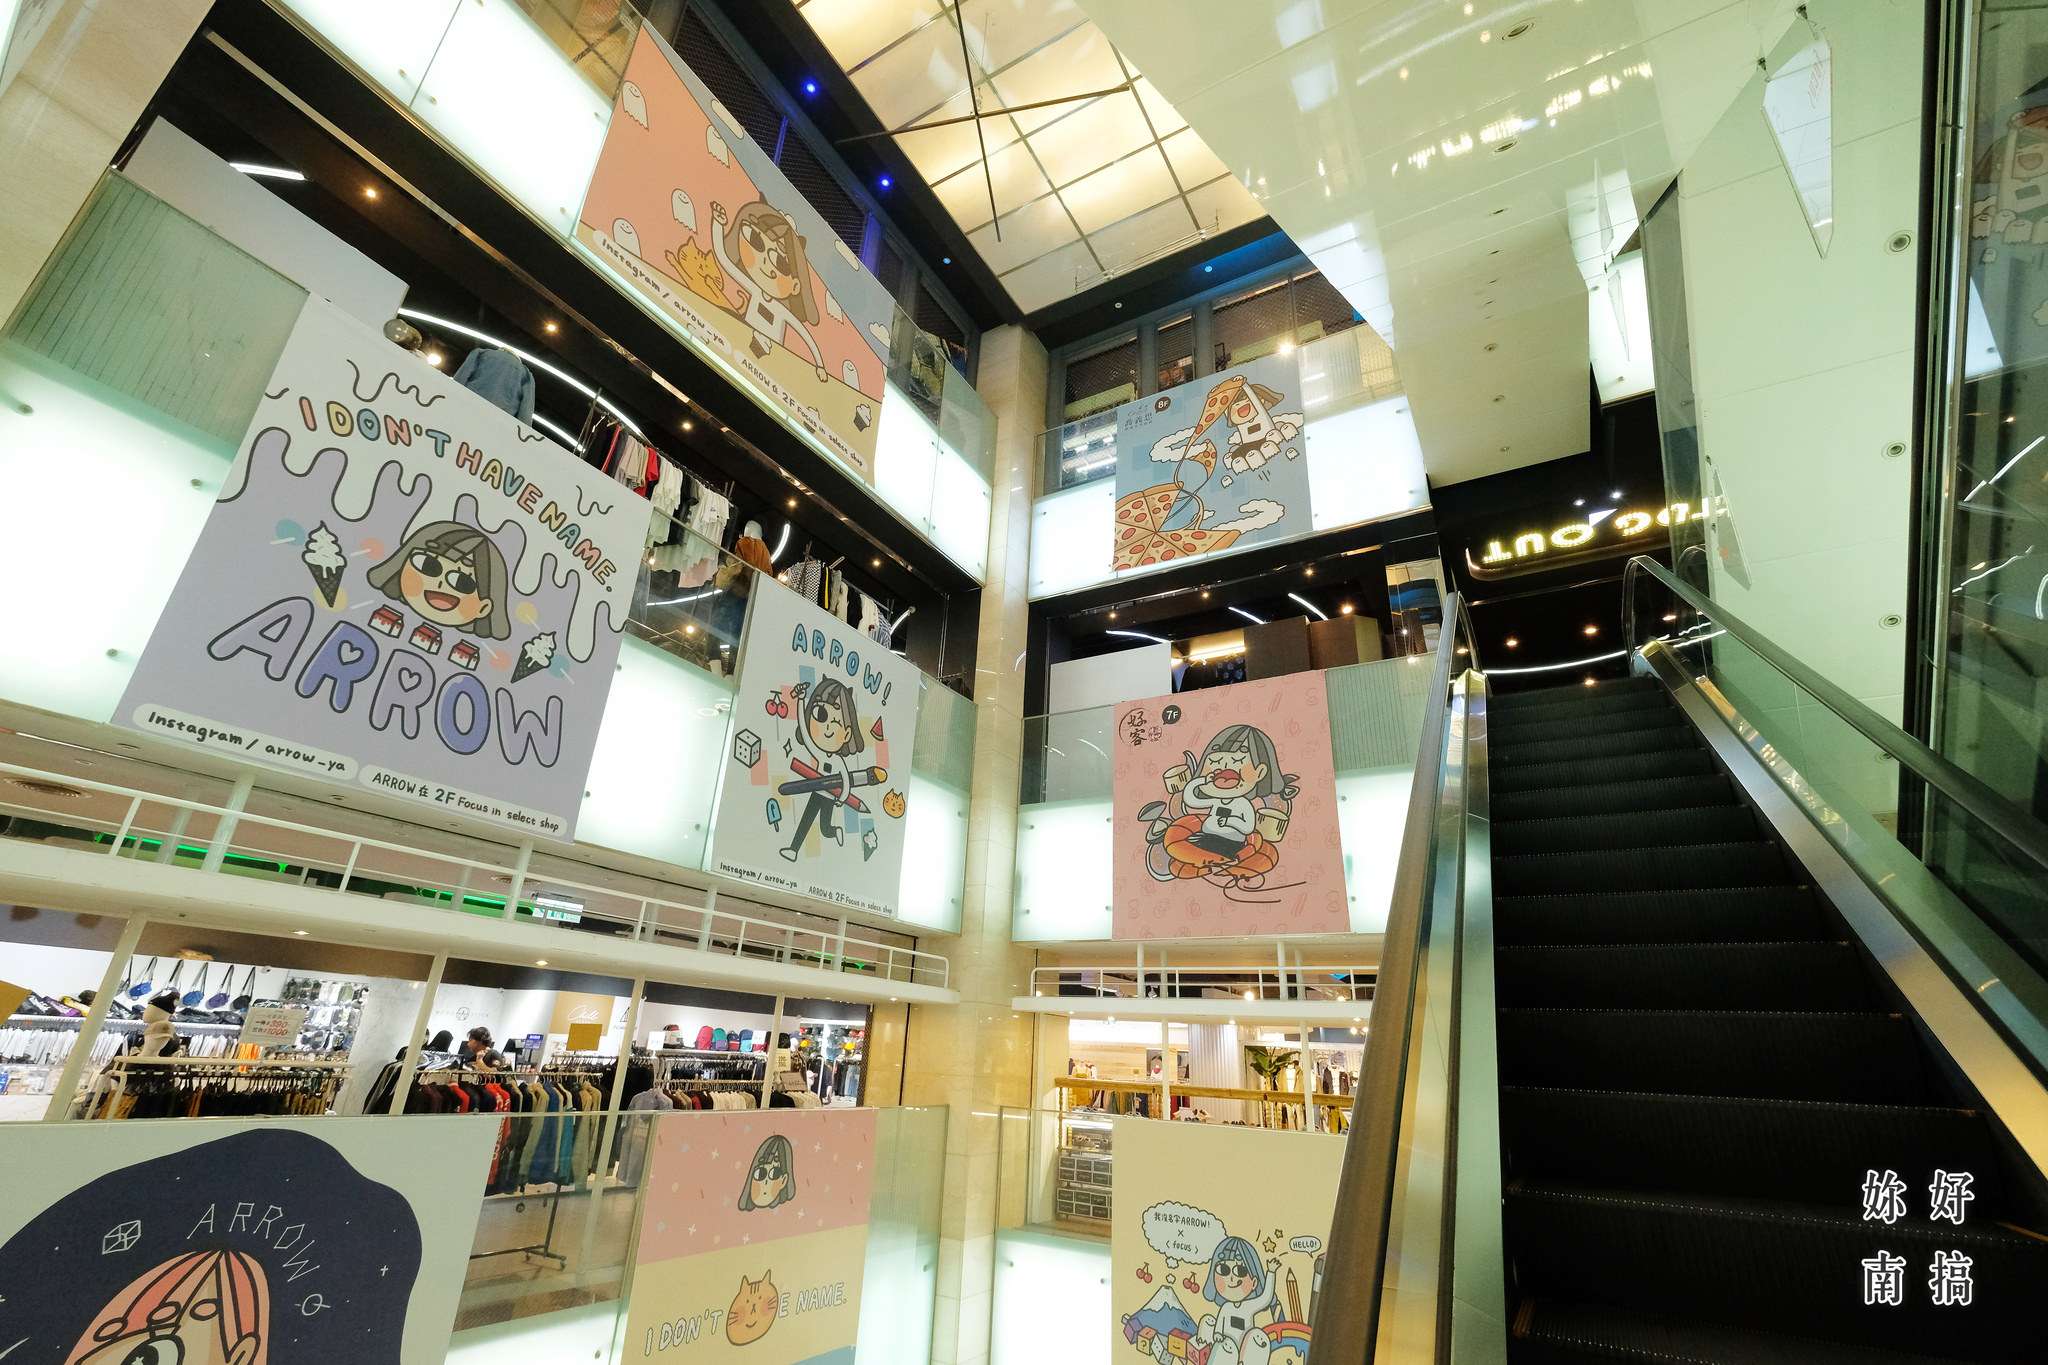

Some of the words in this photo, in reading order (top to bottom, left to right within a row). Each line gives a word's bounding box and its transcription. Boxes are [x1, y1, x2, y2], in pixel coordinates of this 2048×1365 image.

[602, 239, 661, 292] Instagram
[782, 392, 795, 407] 2F
[1158, 400, 1169, 409] 8F
[299, 396, 317, 431] I
[326, 401, 451, 457] DON'T
[456, 442, 544, 514] HAVE
[538, 501, 617, 592] NAME.
[205, 596, 564, 768] ARROW
[148, 711, 243, 742] Instagram
[1127, 711, 1148, 746] 好客
[1166, 710, 1179, 720] 7F
[371, 771, 417, 794] ARROW
[434, 788, 456, 804] 2F
[457, 796, 489, 813] Focus
[491, 807, 502, 817] in
[507, 811, 536, 826] select
[540, 817, 560, 833] shop
[719, 862, 757, 879] Instagram
[808, 885, 828, 899] ARROW
[835, 891, 846, 903] 2F
[845, 896, 860, 907] Focus
[1292, 1240, 1317, 1249] HELLO!
[644, 1328, 654, 1357] I
[659, 1308, 724, 1351] DON'T
[796, 1281, 848, 1316] NAME.
